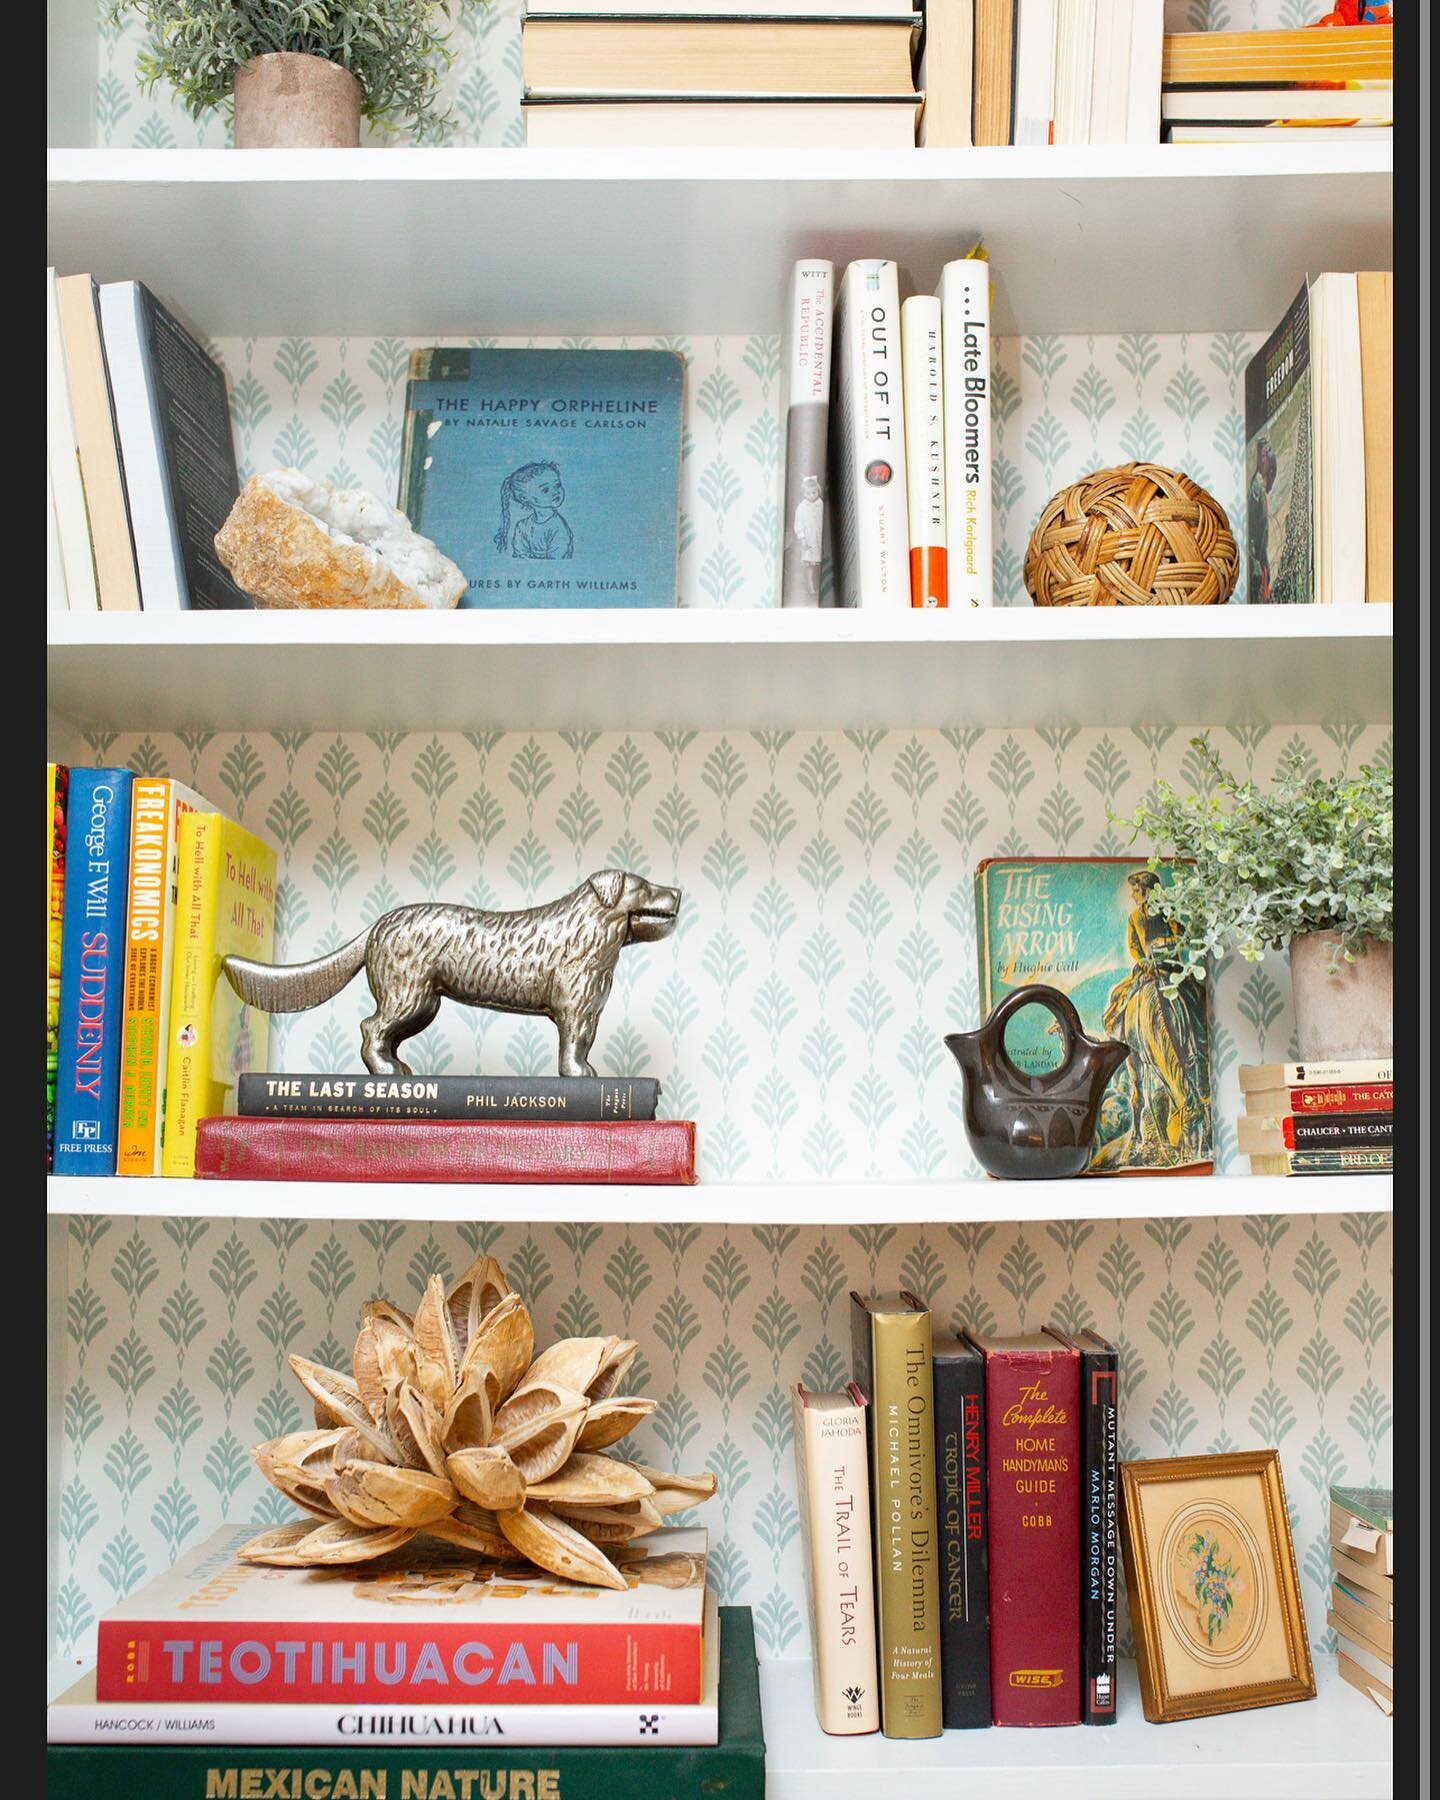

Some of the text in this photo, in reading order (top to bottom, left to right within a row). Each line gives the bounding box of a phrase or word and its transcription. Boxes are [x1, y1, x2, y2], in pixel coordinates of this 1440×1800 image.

[801, 271, 829, 279] WITT
[798, 298, 811, 366] REPUBLIC
[812, 308, 826, 397] ACCIDENTAL
[870, 307, 891, 440] OUT OF IT
[928, 331, 938, 402] HAROLD
[436, 398, 658, 413] THE HAPPY ORPHELINE
[963, 321, 986, 484] Late Bloomers
[444, 418, 647, 430] BY NATALIE SAVAGE CARLSON
[930, 440, 941, 524] KUSHNER
[964, 489, 978, 575] Rich Karlgaard
[877, 505, 888, 593] STUART WALTON
[468, 579, 638, 591] URES BY GARTH WILLIAMS
[84, 785, 114, 918] George F. Will
[130, 784, 166, 942] FREAKONOMICS
[189, 824, 206, 939] To Hell with All That
[225, 853, 274, 903] To Hell with
[995, 868, 1053, 902] THE
[232, 901, 265, 938] All That
[997, 902, 1073, 929] RISING
[997, 930, 1082, 957] ARROW
[997, 961, 1009, 979] by
[75, 932, 109, 1100] SUDDENLY
[1008, 1046, 1052, 1059] strated by
[177, 1056, 191, 1137] Caitlin Flanagan
[266, 1080, 438, 1099] THE LAST SEASON
[466, 1095, 566, 1108] PHIL JACKSON
[1352, 1091, 1370, 1101] THE
[328, 1105, 364, 1113] SEARCH
[1296, 1124, 1393, 1137] CHAUCER THE CANT
[59, 1143, 113, 1153] FREE PRESS
[1019, 1380, 1049, 1405] The
[822, 1416, 860, 1427] GLORIA
[1002, 1404, 1068, 1430] Complete
[821, 1427, 862, 1438] JAHODA
[1015, 1438, 1056, 1451] HOME
[965, 1394, 983, 1540] HENRY MILLER
[1002, 1456, 1069, 1472] HANDYMAN'S
[888, 1404, 903, 1572] MICHAEL POLLAN
[905, 1343, 931, 1632] The Omnivore's Dilemma
[1015, 1480, 1056, 1493] GUIDE
[1022, 1515, 1052, 1527] COBB
[1090, 1469, 1100, 1600] MARLO MORGAN
[1106, 1407, 1116, 1663] MUTANT MESSAGE DOWN UNDER
[834, 1466, 858, 1647] THE TRAIL OF TEARS
[126, 1640, 137, 1684] ROBB
[163, 1640, 579, 1685] TEOTIHUACAN
[892, 1645, 932, 1655] A Natural
[891, 1670, 935, 1680] Four Meals
[893, 1657, 933, 1671] History of
[1015, 1674, 1051, 1684] WISE
[94, 1719, 155, 1731] HANCOCK
[164, 1719, 216, 1731] WILLIAMS
[337, 1715, 504, 1737] CHIHUAHUA
[205, 1768, 560, 1800] MEXICAN NATURE
